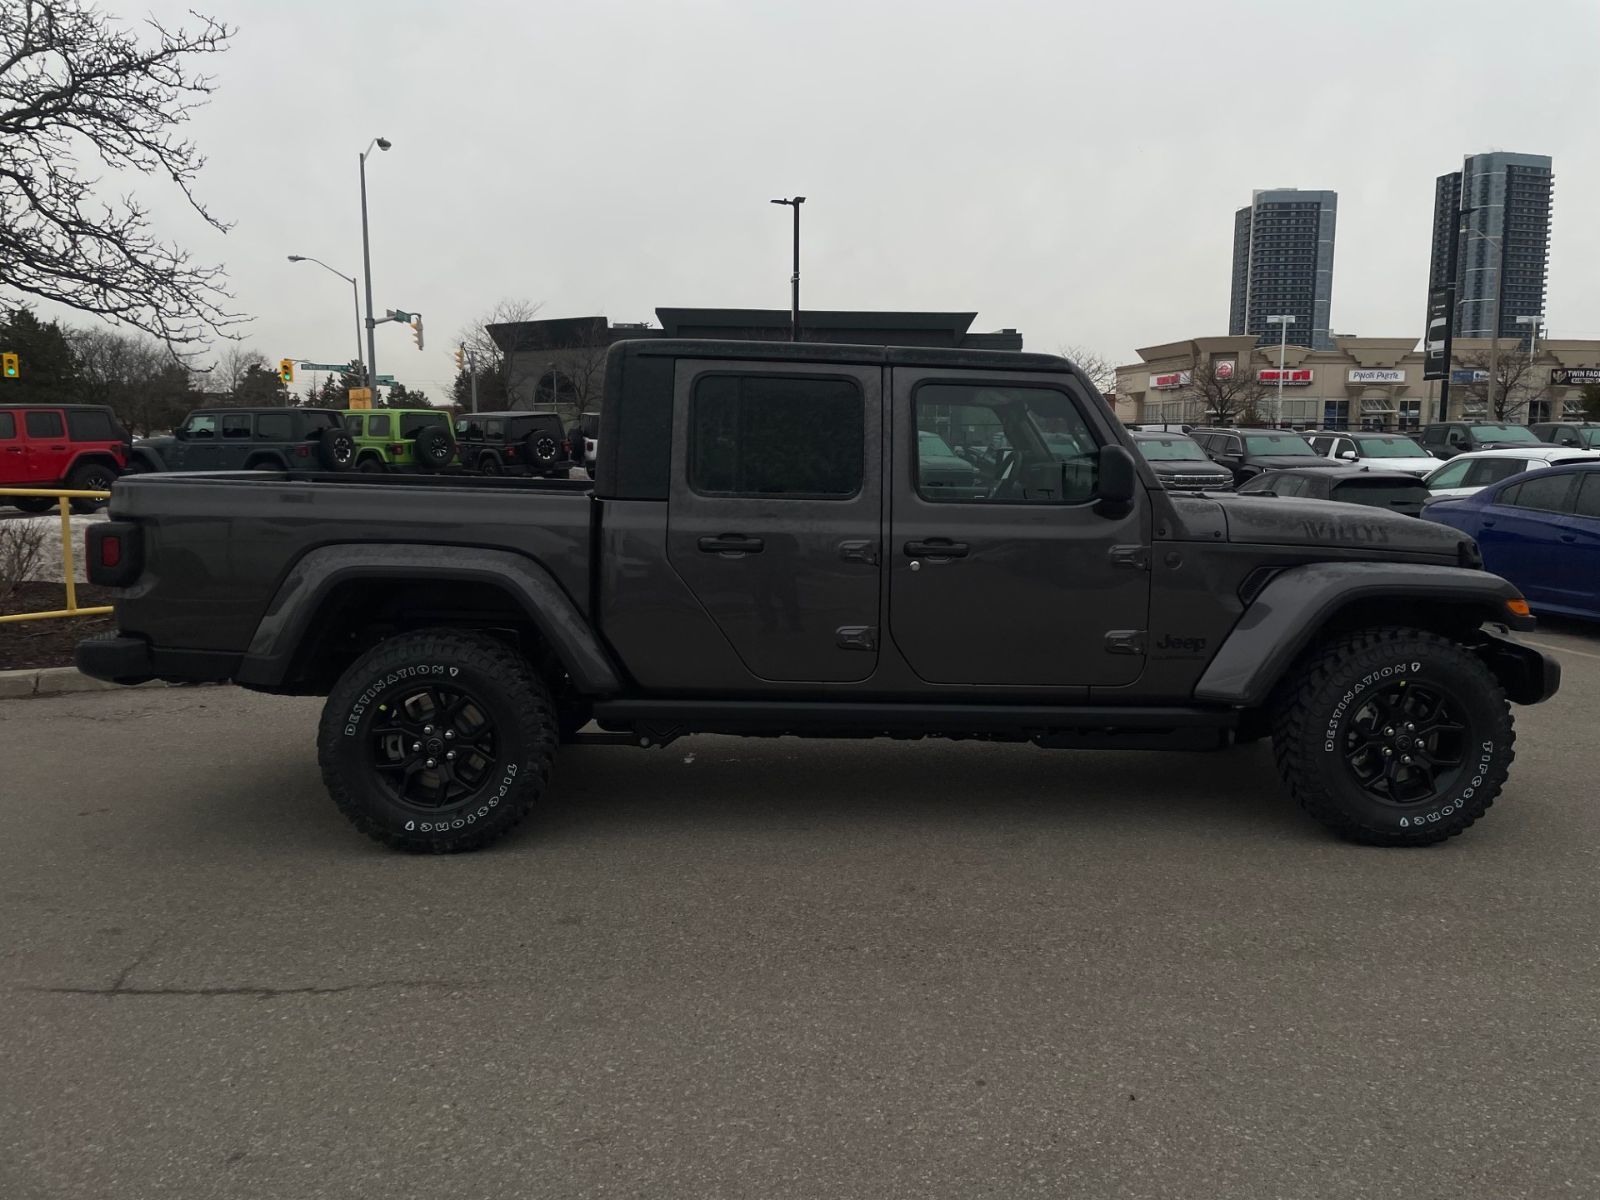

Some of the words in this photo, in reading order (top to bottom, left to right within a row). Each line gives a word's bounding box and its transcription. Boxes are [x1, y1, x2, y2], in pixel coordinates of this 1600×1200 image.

[1301, 519, 1390, 543] WILLYS
[1156, 633, 1206, 652] Jeep
[344, 665, 444, 737] DESTINATION
[1325, 663, 1407, 751] DESTINATION
